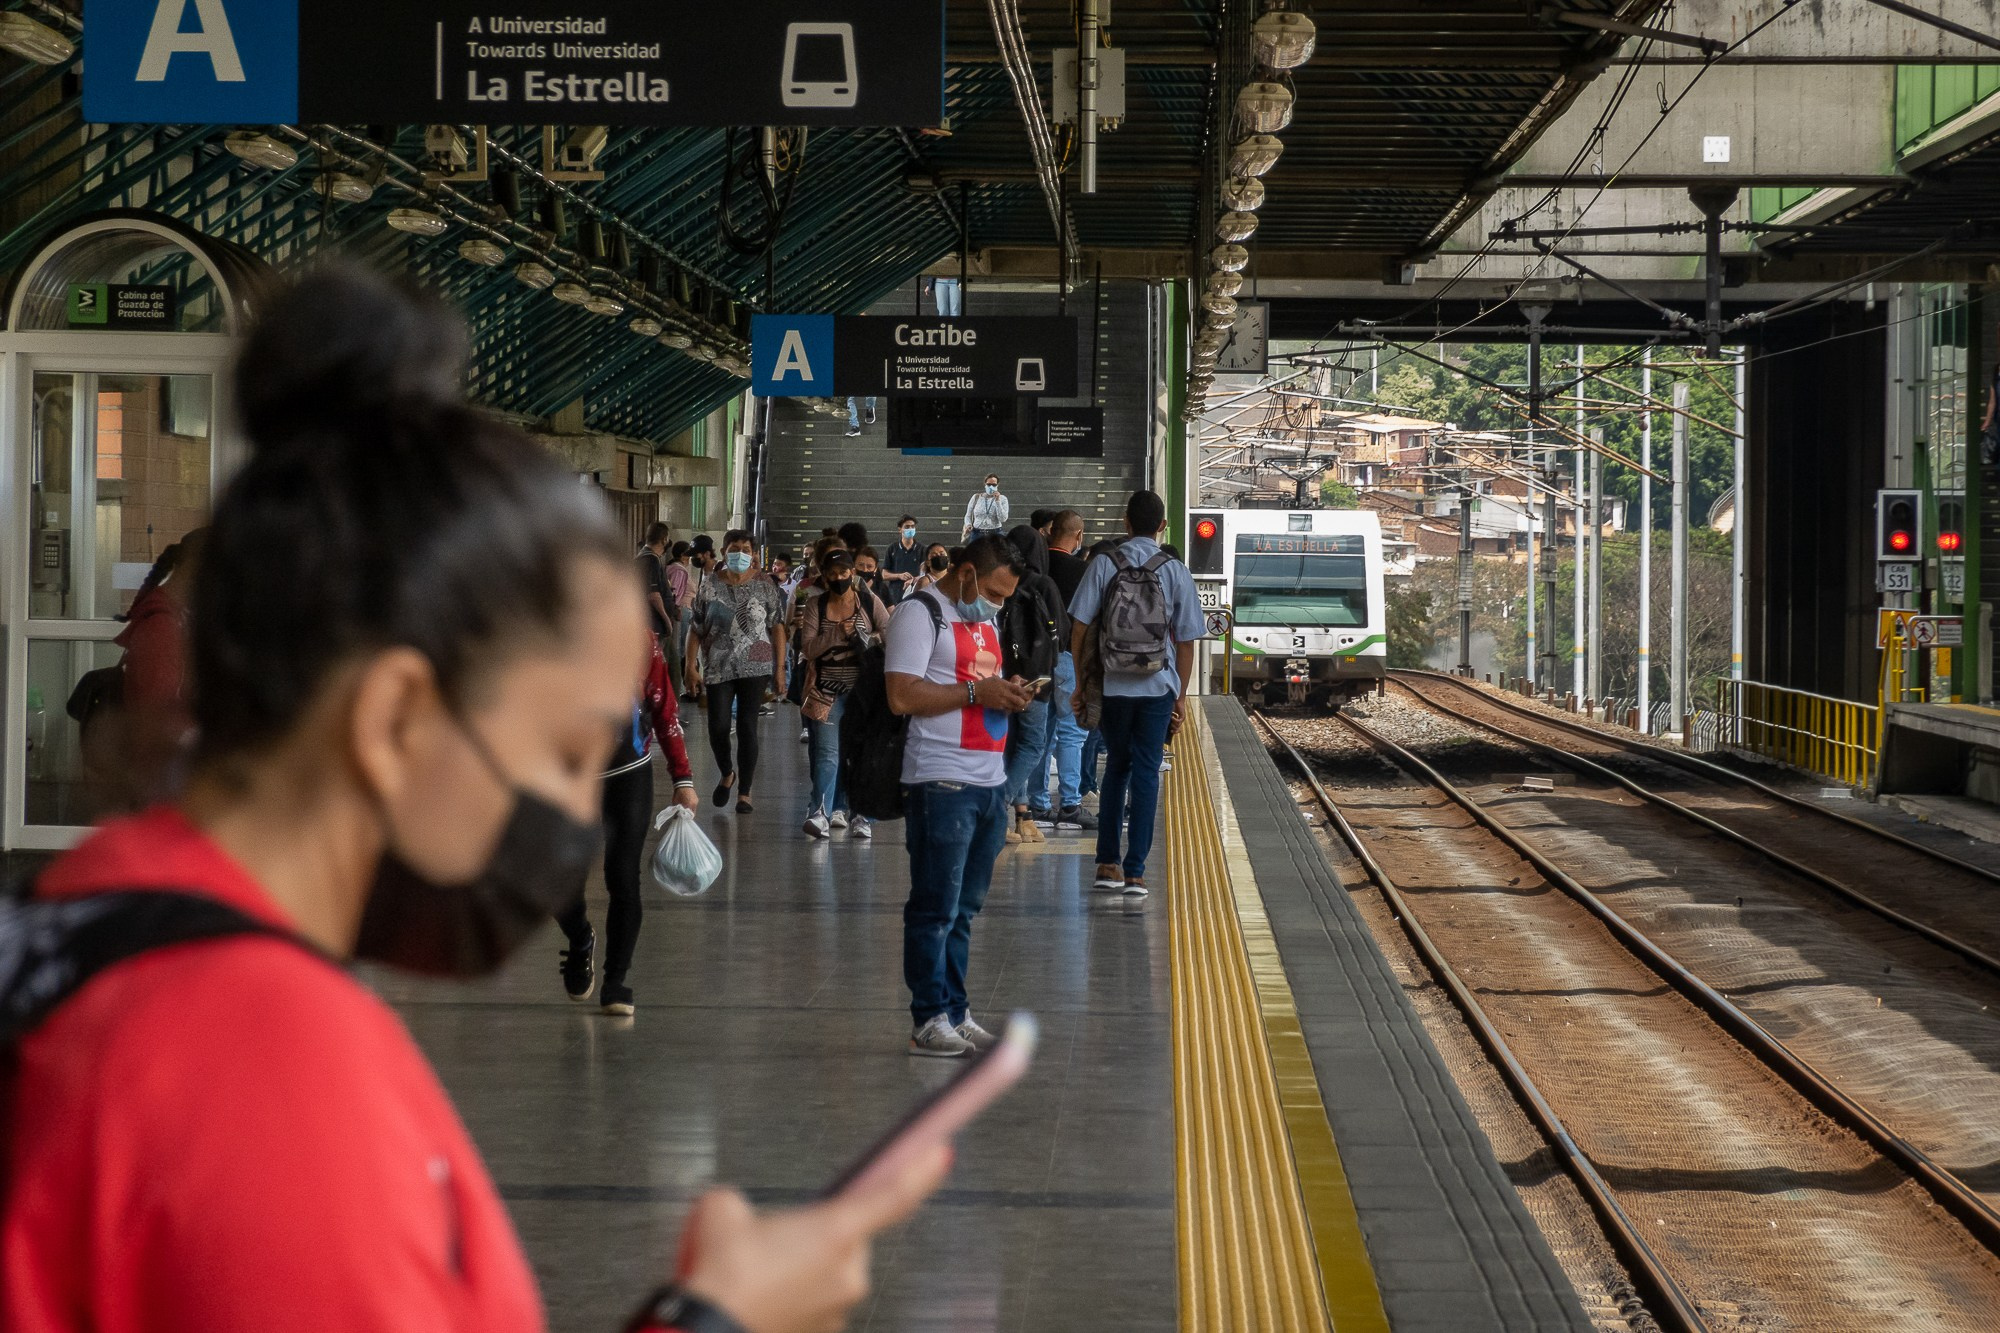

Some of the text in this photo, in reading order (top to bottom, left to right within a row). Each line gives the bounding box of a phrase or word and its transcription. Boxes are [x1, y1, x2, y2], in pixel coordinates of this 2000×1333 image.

[468, 15, 606, 35] A Universidad
[135, 0, 246, 83] A
[467, 41, 661, 59] Towards Universidad
[467, 70, 669, 103] La Estrella
[118, 291, 164, 299] Cabina del
[118, 300, 164, 309] Guarda de
[118, 309, 165, 318] Protección
[894, 322, 977, 346] Caribe
[771, 329, 814, 381] A
[896, 355, 950, 364] A Universidad
[896, 365, 971, 373] Towards Universidad
[896, 376, 974, 390] La Estrella
[1257, 540, 1340, 552] LA ESTRELLA
[1891, 565, 1907, 573] CAR
[1198, 583, 1213, 591] CAR
[1888, 574, 1909, 588] S31
